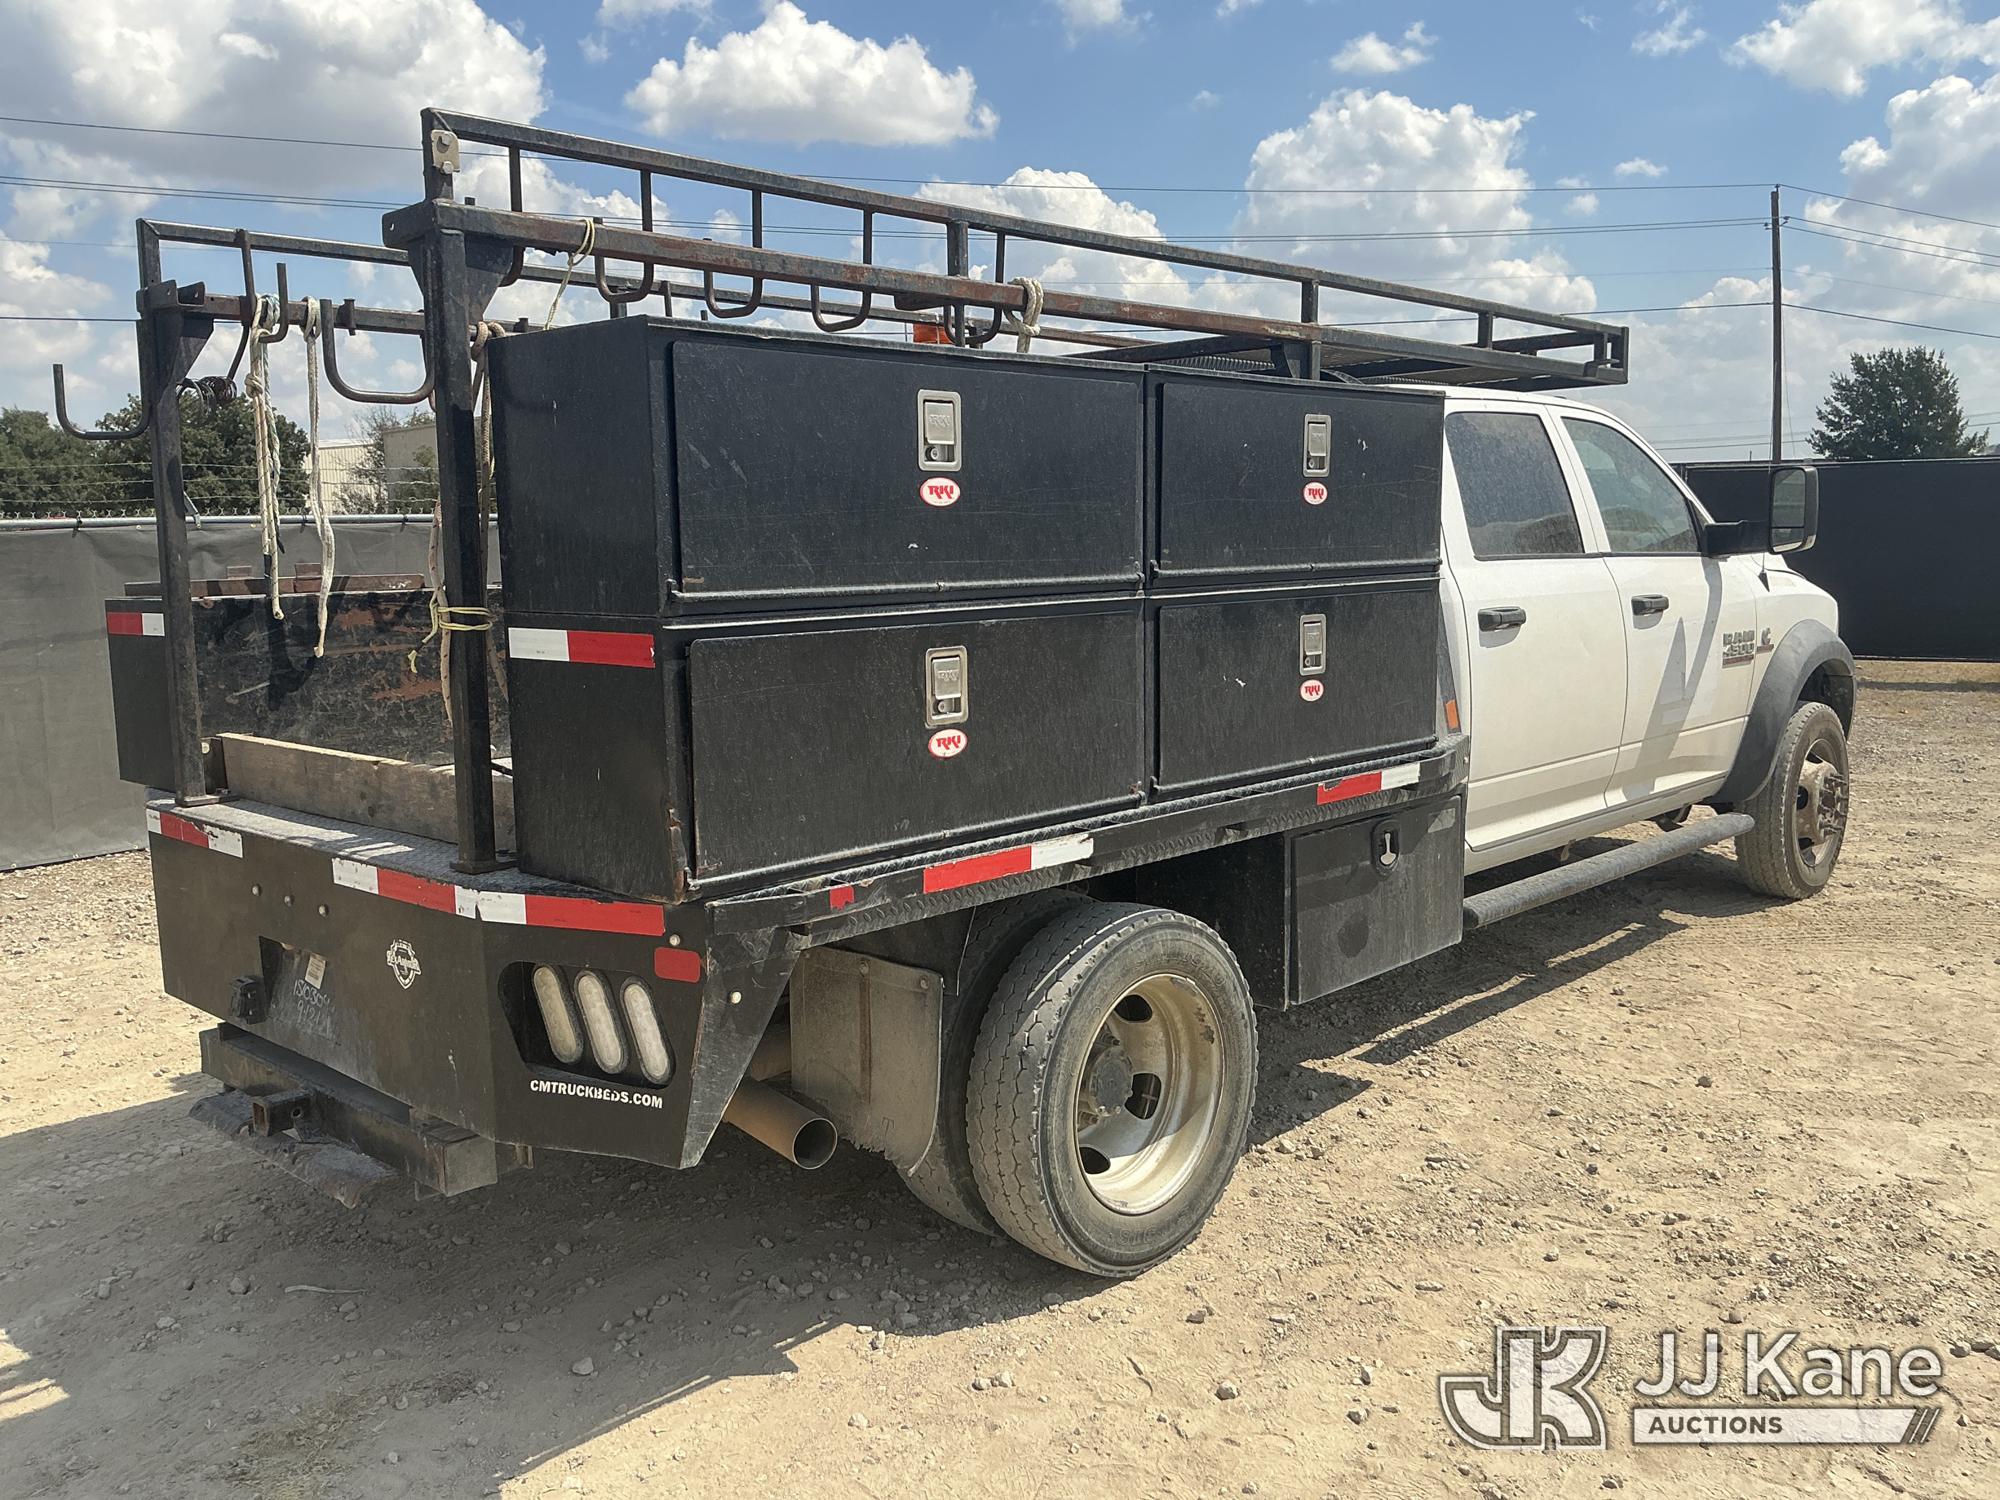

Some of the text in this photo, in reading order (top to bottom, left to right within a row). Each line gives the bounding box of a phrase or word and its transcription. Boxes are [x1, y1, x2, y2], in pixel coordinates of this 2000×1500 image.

[927, 485, 954, 500] RKI
[1722, 630, 1755, 646] RAM
[530, 1080, 663, 1109] CMTRUCKBEDS.COM
